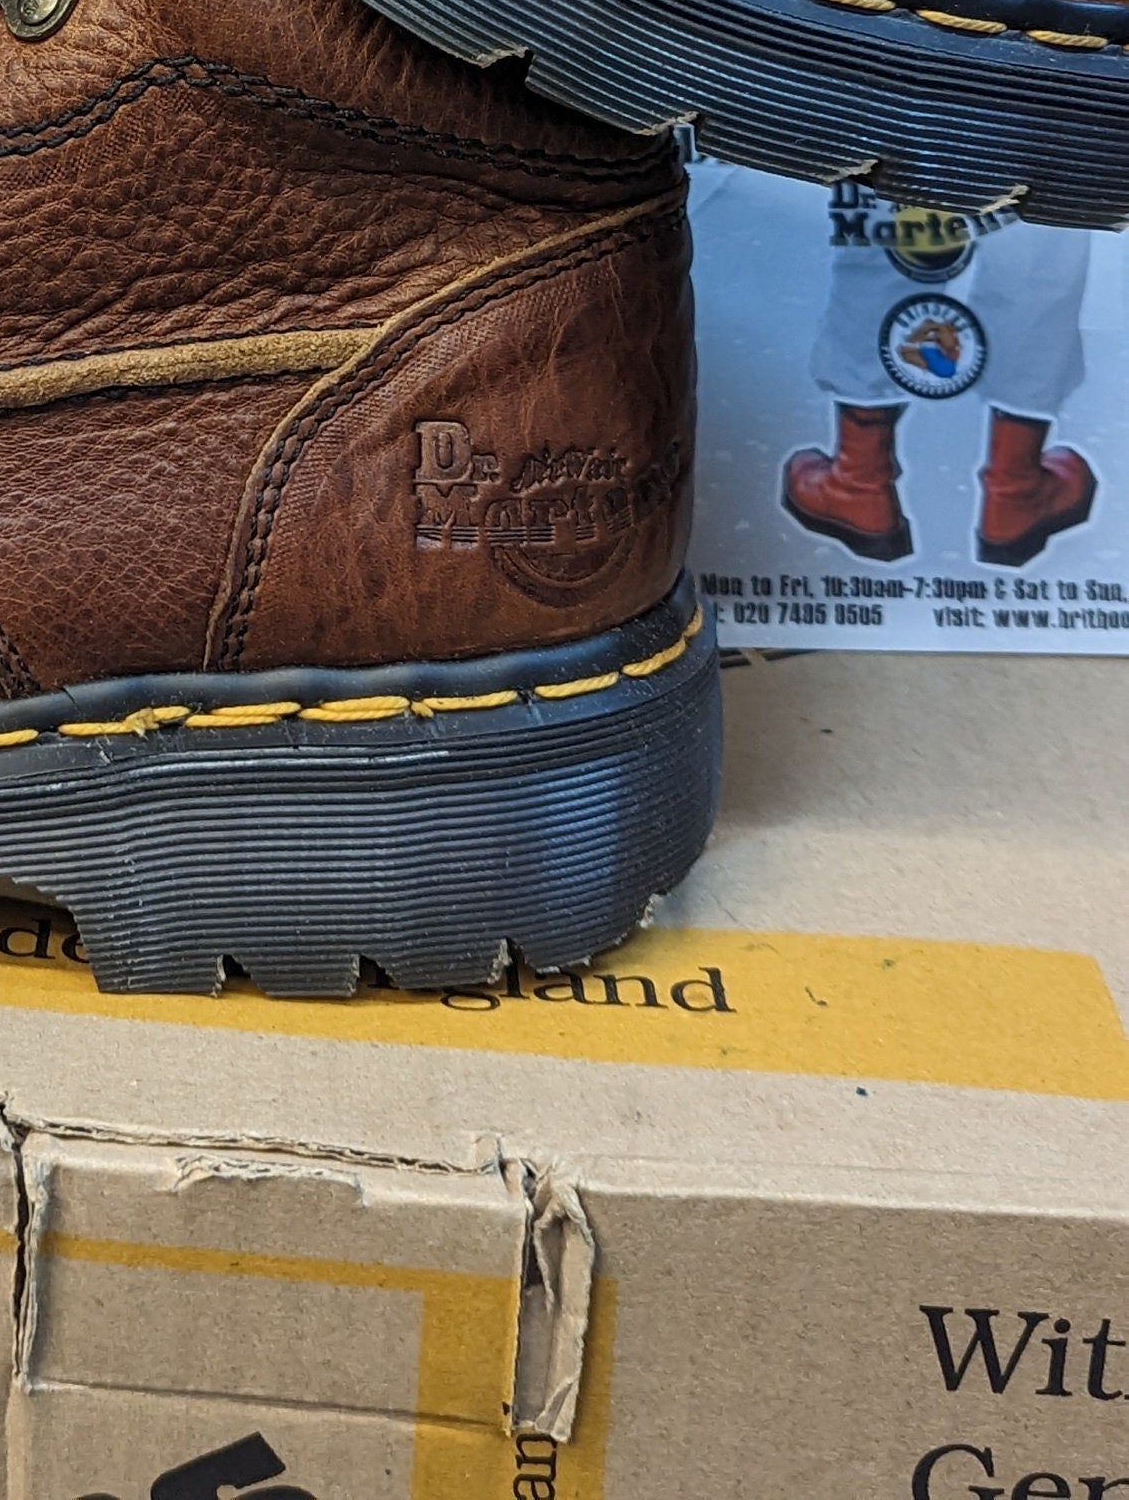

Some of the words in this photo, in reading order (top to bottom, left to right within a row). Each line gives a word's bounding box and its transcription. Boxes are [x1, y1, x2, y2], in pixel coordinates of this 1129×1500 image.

[1013, 578, 1049, 601] Sat
[1056, 579, 1078, 601] to
[919, 1304, 1129, 1400] Wit
